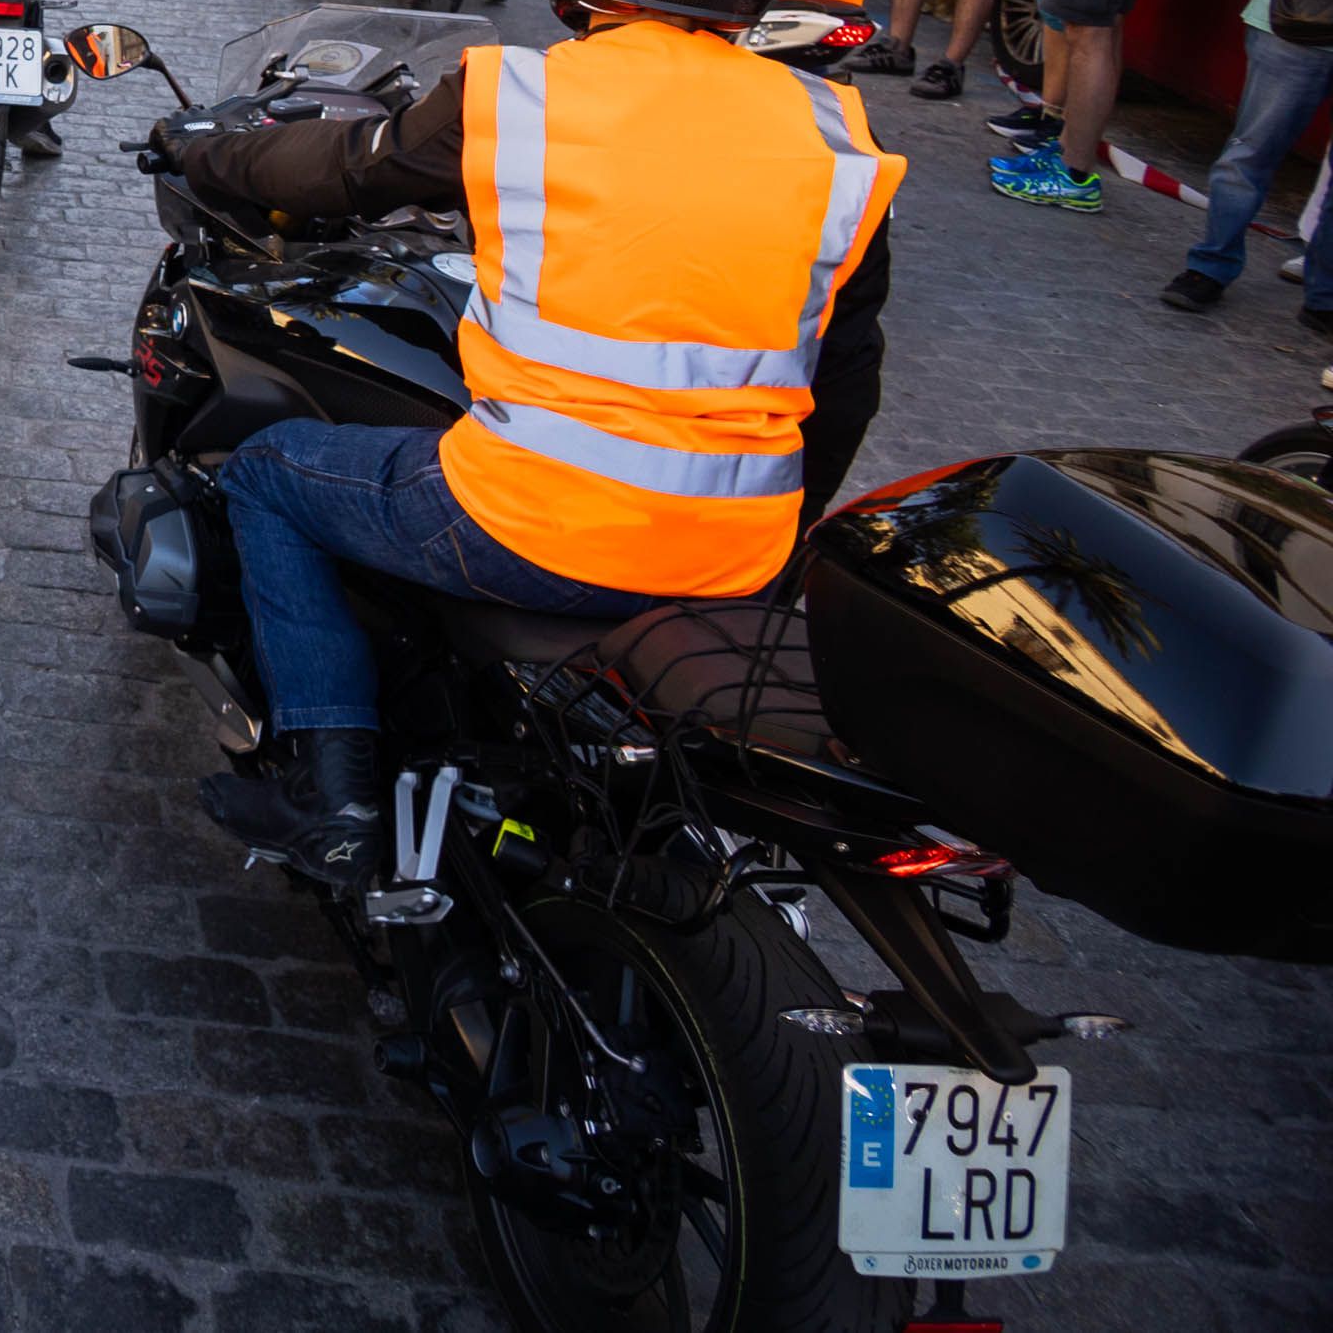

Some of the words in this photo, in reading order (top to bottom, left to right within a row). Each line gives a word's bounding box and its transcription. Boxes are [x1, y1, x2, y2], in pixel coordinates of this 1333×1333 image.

[903, 1081, 1058, 1157] 7947
[863, 1142, 881, 1167] E
[921, 1166, 1036, 1241] LRD
